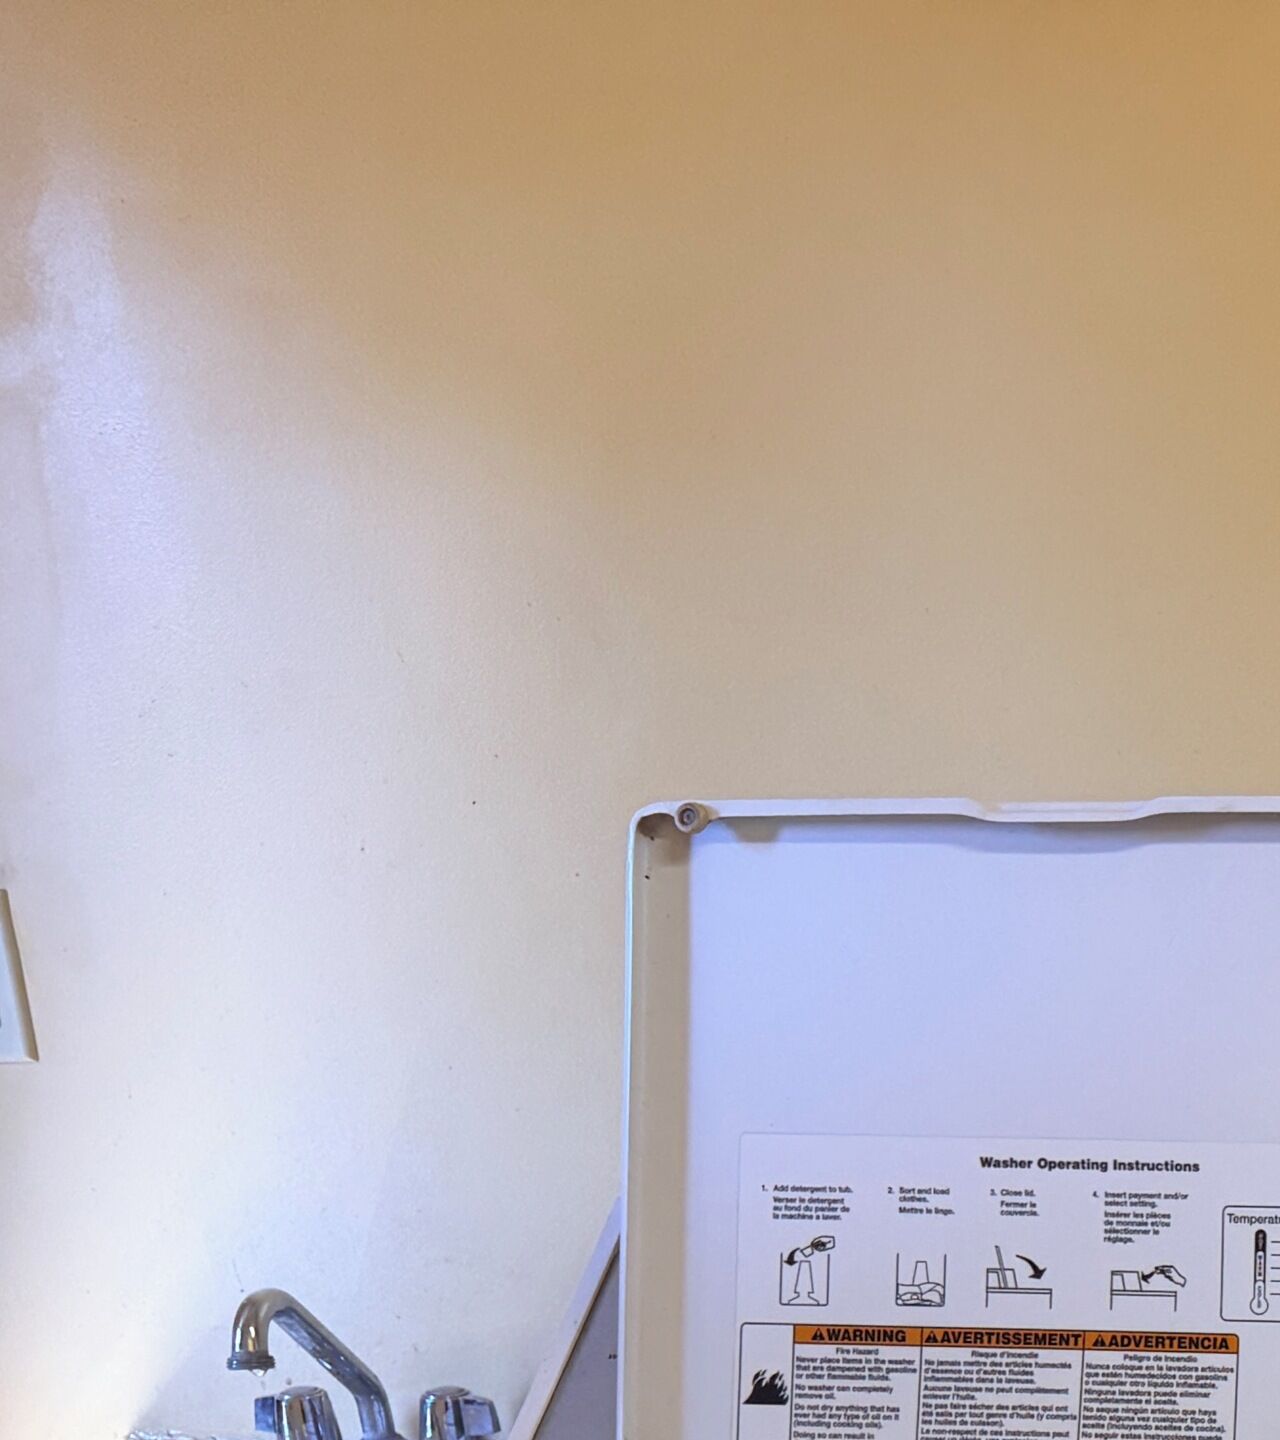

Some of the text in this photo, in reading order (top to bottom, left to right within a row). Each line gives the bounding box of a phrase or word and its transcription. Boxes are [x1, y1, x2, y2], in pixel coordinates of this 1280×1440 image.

[979, 1157, 1200, 1173] Washer Operating Instructions
[826, 1328, 907, 1342] WARNING
[940, 1331, 1082, 1346] AVERTISSEMENT
[1108, 1336, 1229, 1349] ADVERTENCIA
